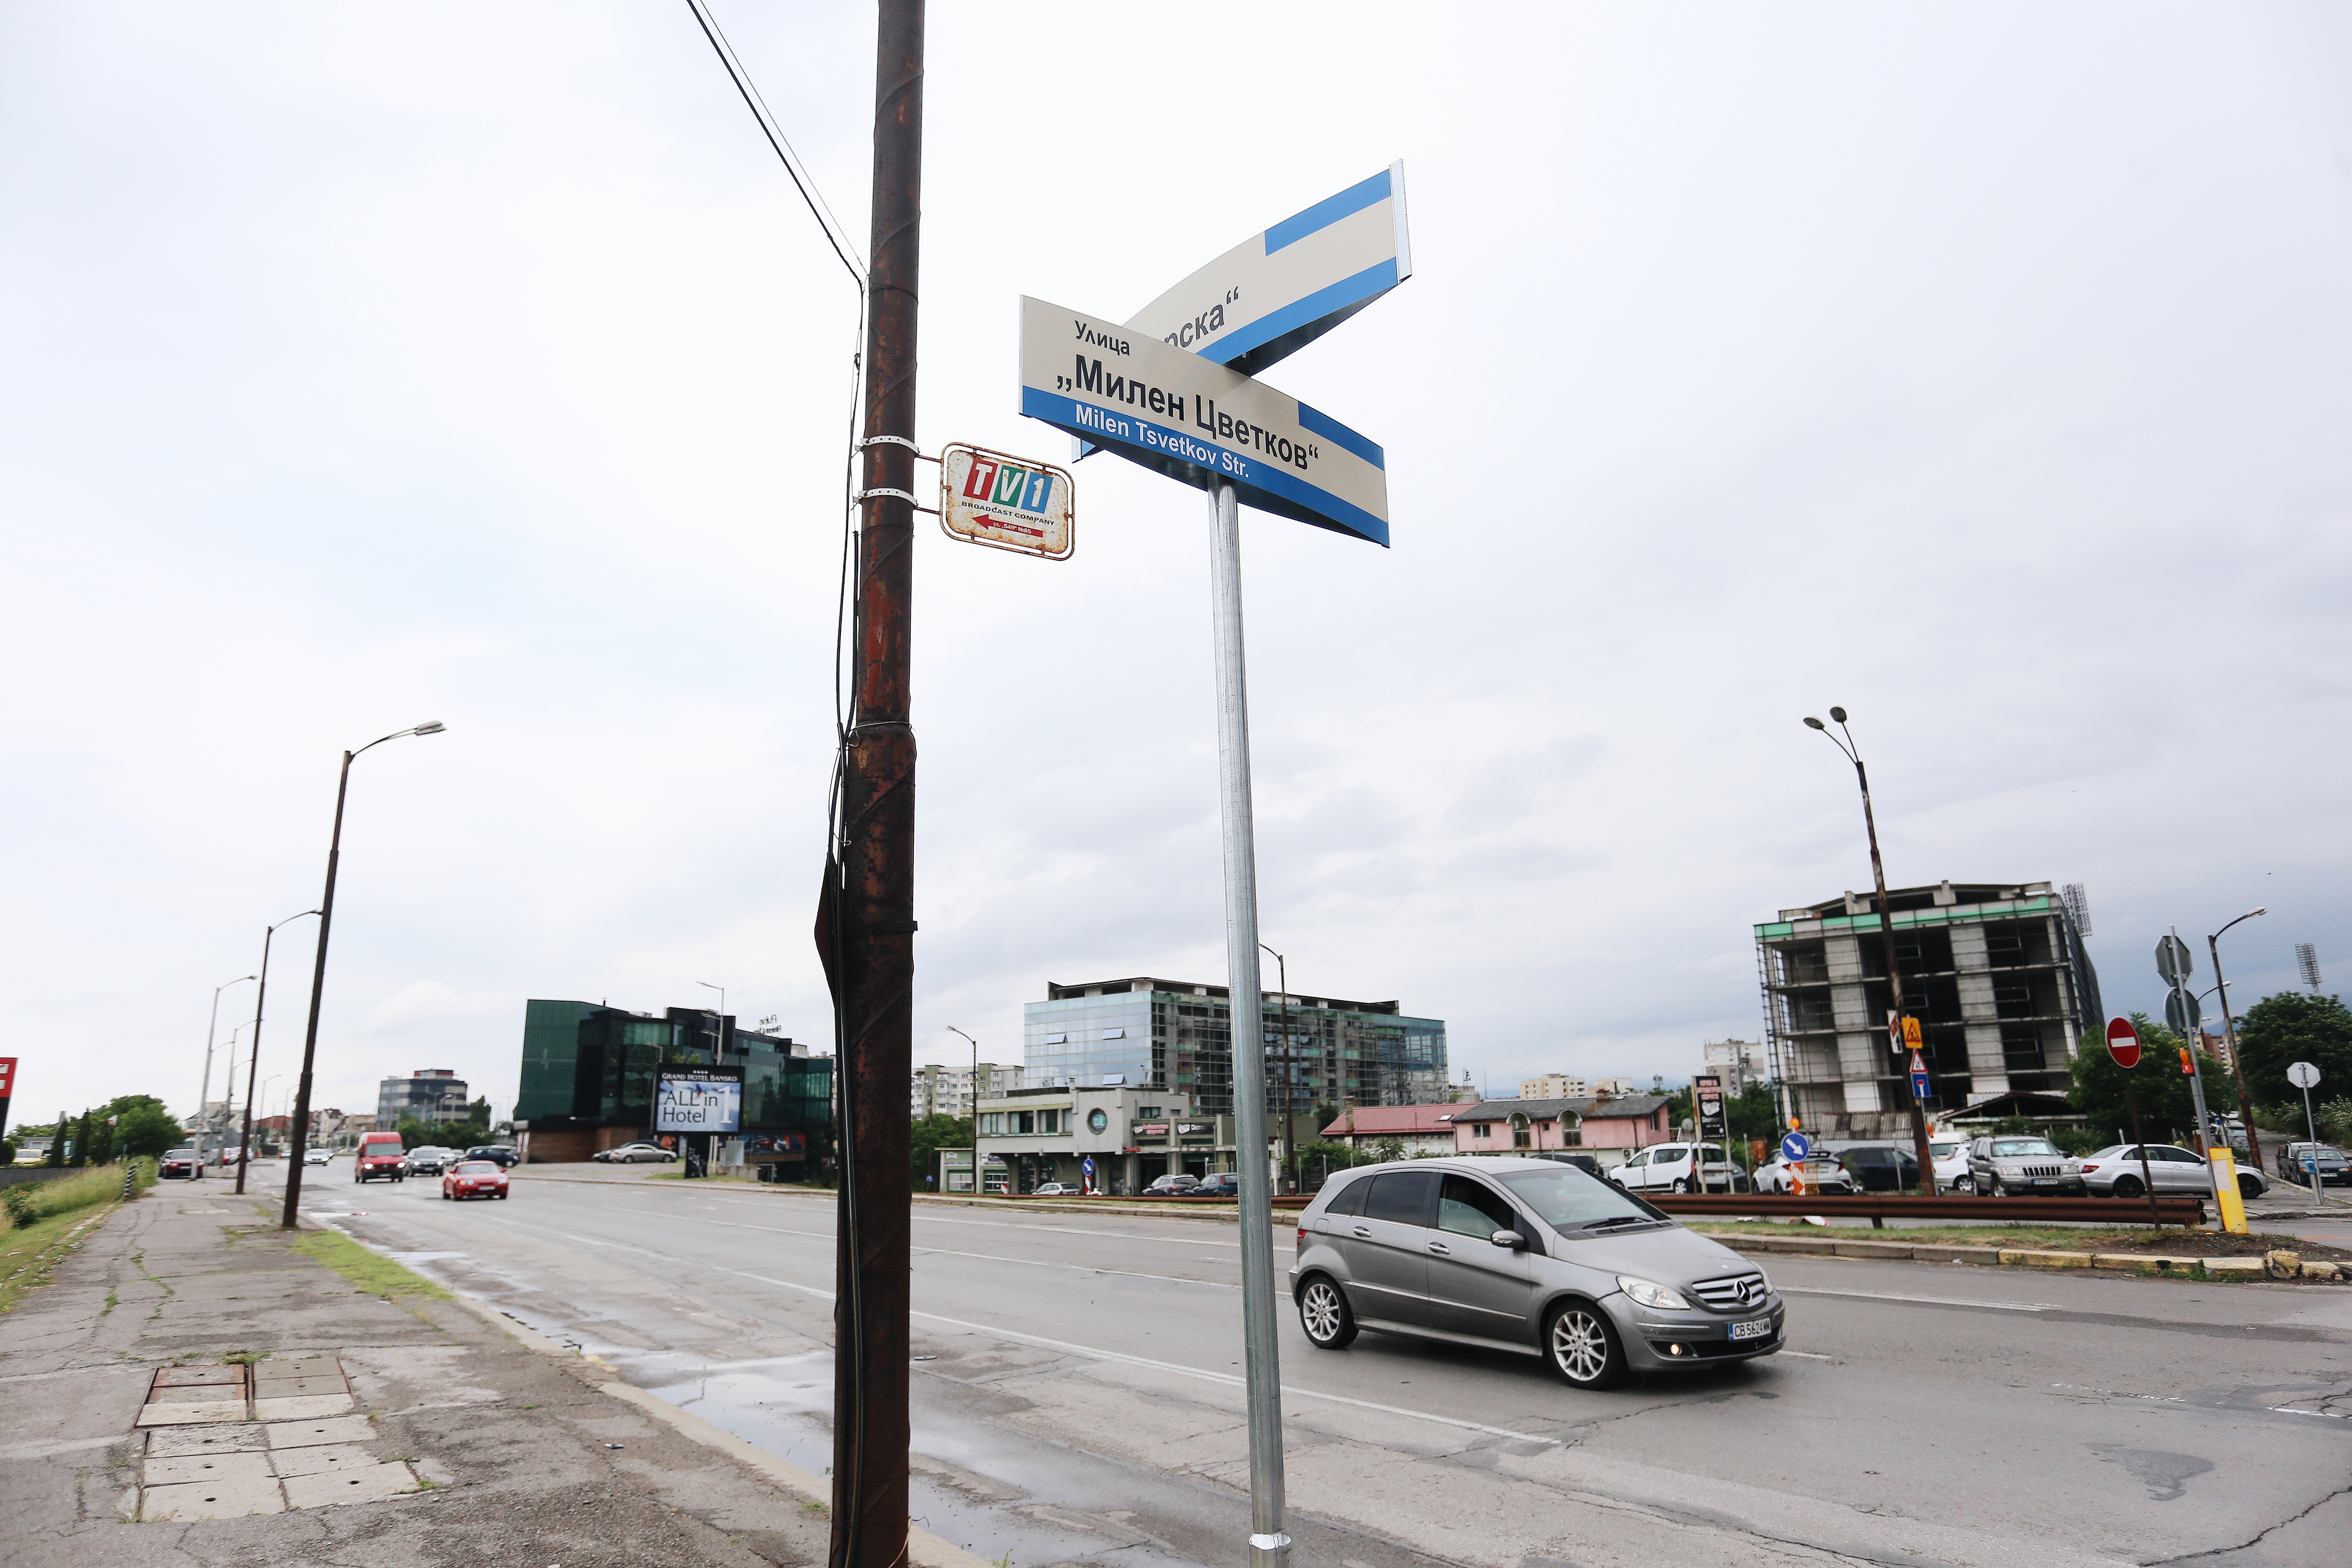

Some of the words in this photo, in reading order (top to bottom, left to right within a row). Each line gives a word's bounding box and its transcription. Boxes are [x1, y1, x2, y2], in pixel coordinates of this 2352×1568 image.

[1074, 320, 1130, 356] Улица
[1057, 354, 1185, 421] „Милен
[1195, 394, 1319, 470] Цветков“
[1075, 403, 1129, 438] Milen
[1135, 421, 1217, 465] Tsvetkov
[1222, 452, 1249, 478] Str.
[972, 462, 1045, 508] TV1
[962, 501, 1013, 517] BROADCAST
[1014, 513, 1054, 526] COMPANY
[662, 1072, 686, 1080] GRAND
[663, 1107, 705, 1123] Hotel
[664, 1090, 699, 1106] ALL
[704, 1092, 718, 1107] in
[717, 1086, 733, 1124] 1
